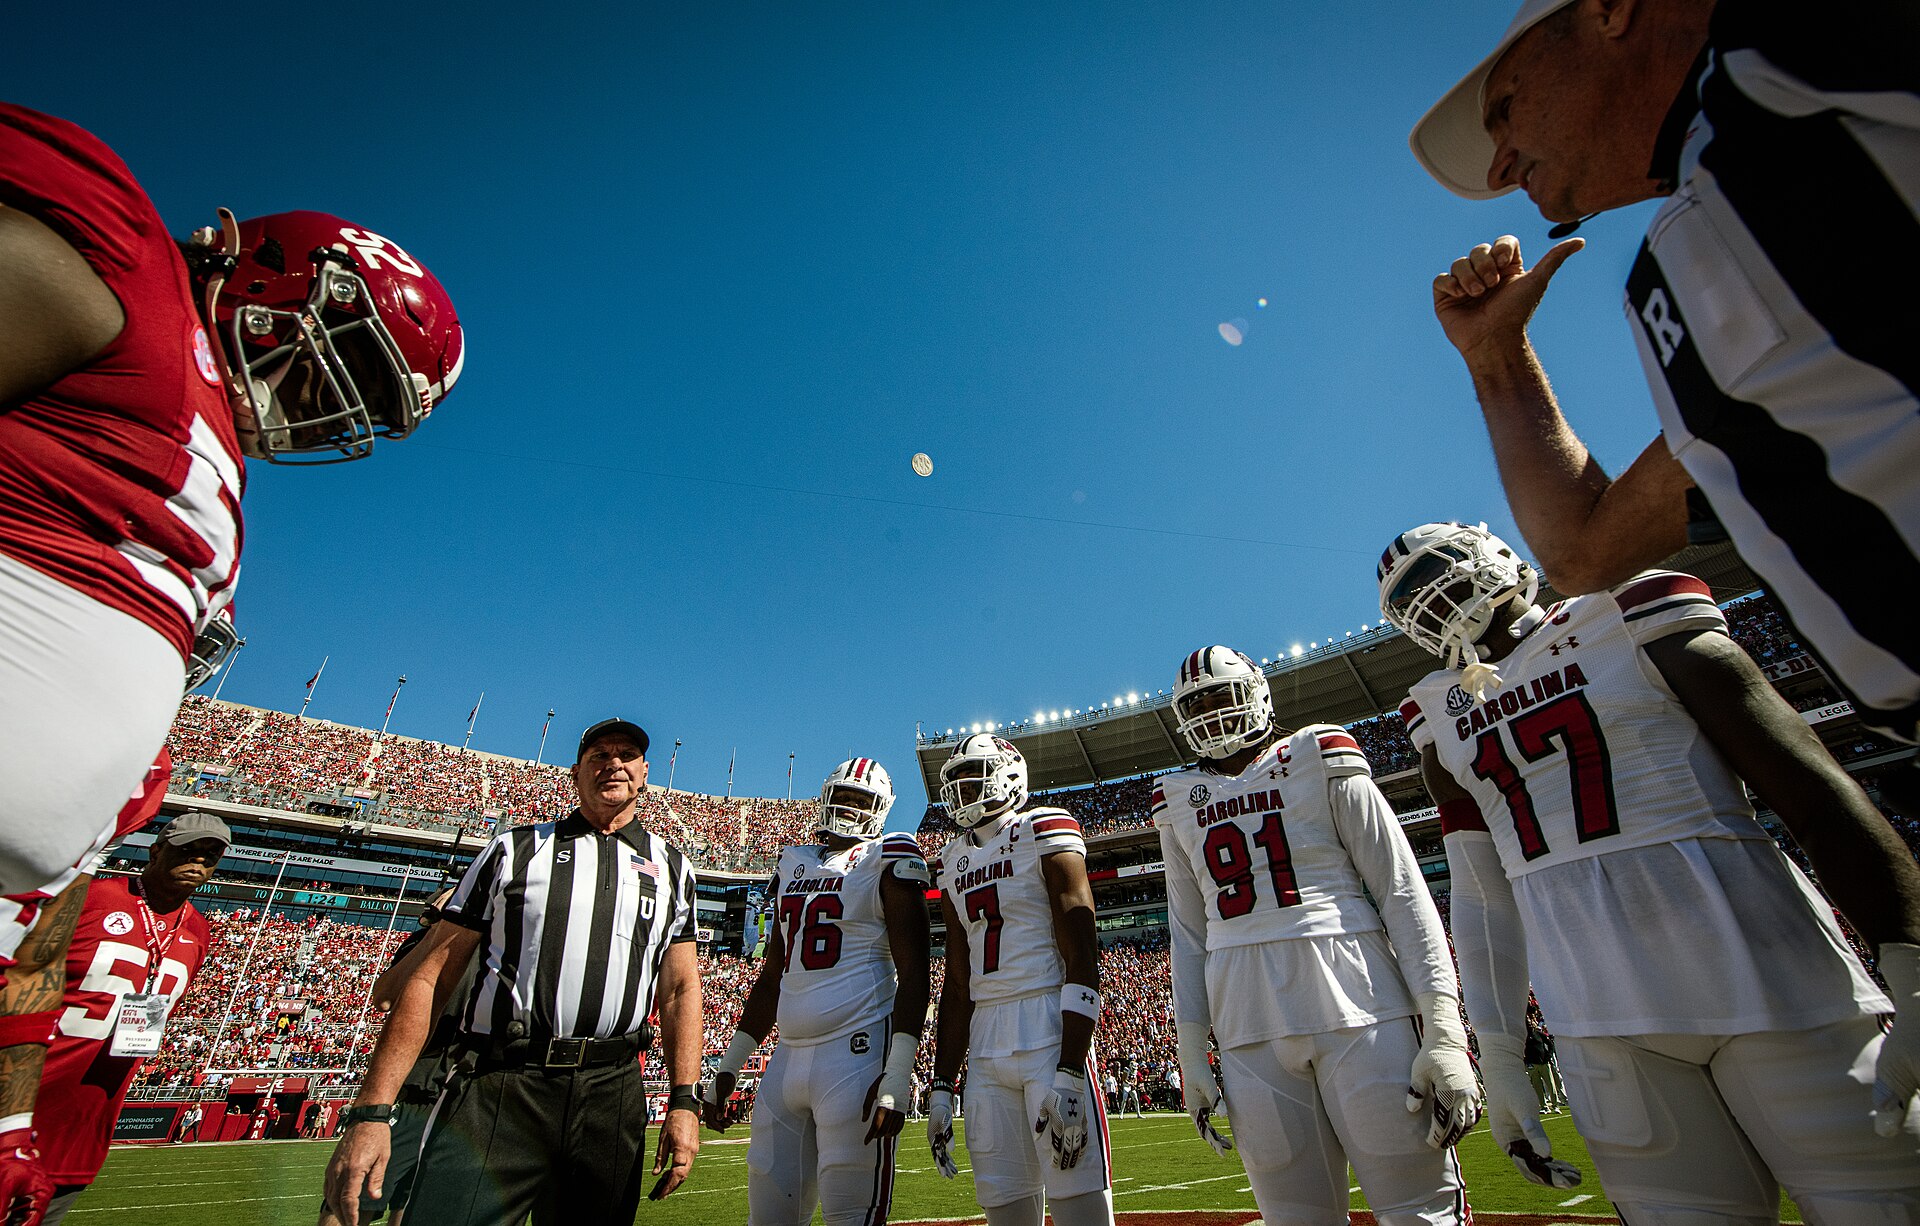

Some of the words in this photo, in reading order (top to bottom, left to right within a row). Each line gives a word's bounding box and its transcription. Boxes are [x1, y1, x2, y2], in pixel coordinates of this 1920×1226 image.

[339, 227, 424, 278] 52
[1641, 288, 1684, 367] R
[1455, 662, 1589, 741] CAROLINA
[1277, 745, 1291, 764] C
[1470, 689, 1620, 862] 17
[1196, 789, 1285, 828] CAROLINA
[1009, 822, 1020, 842] C
[235, 848, 262, 857] WHERE
[312, 858, 335, 866] MADE
[1203, 812, 1302, 920] 91
[786, 877, 844, 893] CAROLINA
[954, 860, 1014, 895] CAROLINA
[307, 893, 337, 906] 1:24
[360, 900, 381, 910] BALL
[382, 901, 395, 911] ON
[641, 895, 655, 920] U
[780, 894, 844, 973] 76
[965, 883, 1004, 975] 7
